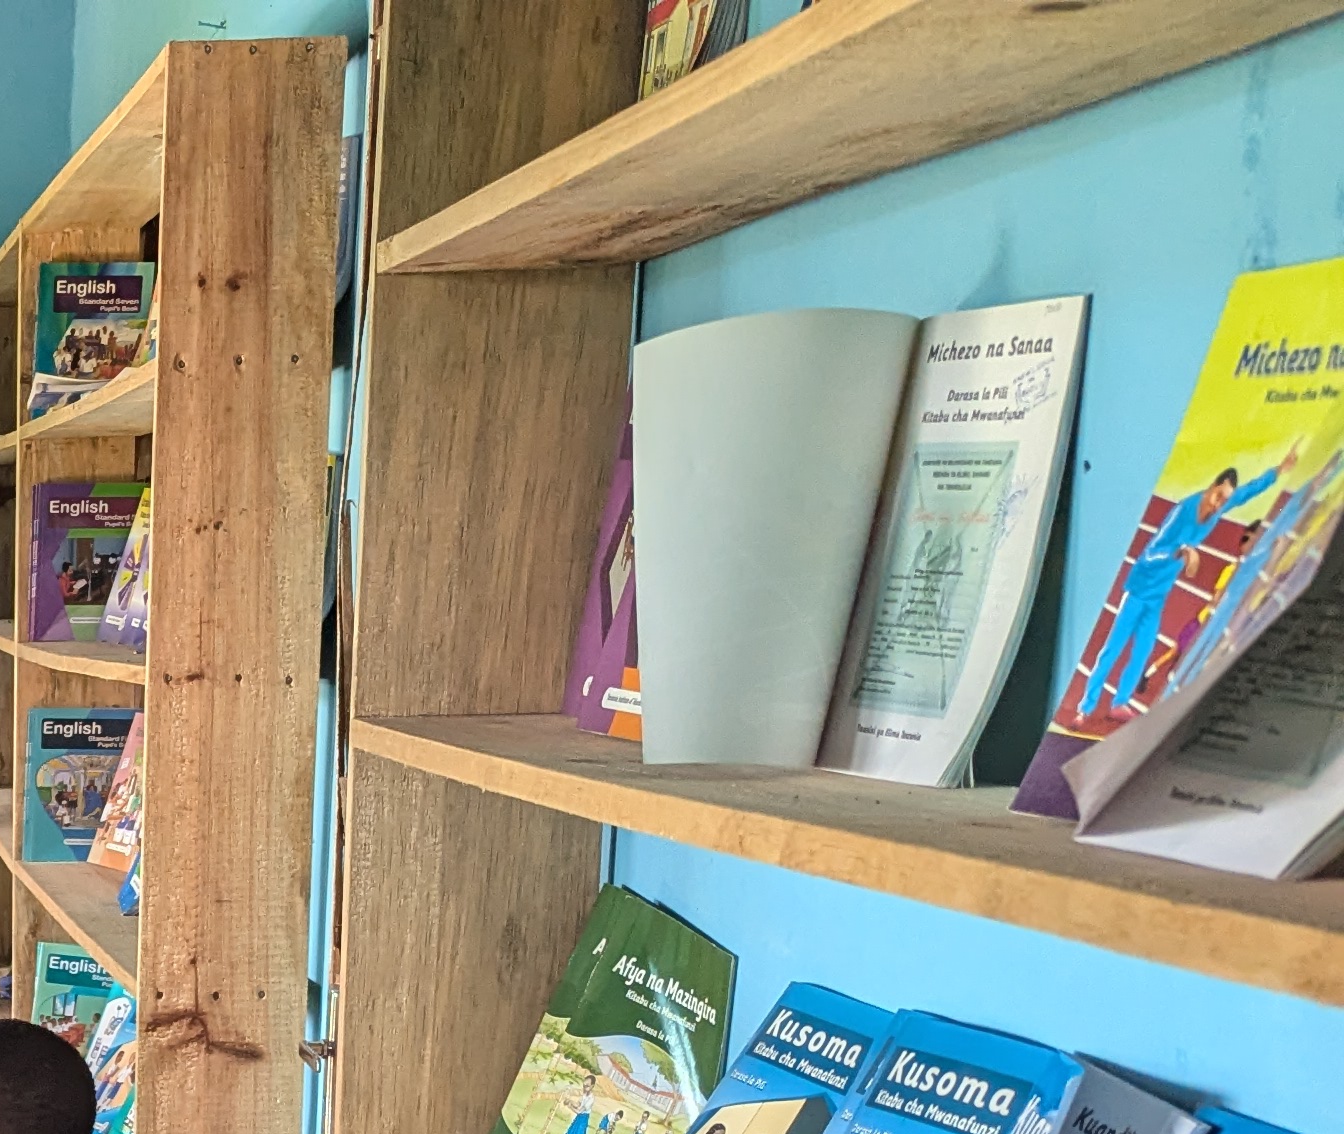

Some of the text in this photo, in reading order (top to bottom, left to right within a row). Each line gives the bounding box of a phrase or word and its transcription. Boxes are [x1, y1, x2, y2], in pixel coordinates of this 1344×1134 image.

[56, 280, 116, 297] English
[927, 336, 1053, 363] Michezo na Sanaa
[1234, 337, 1322, 379] Michezo
[947, 386, 1008, 402] Darasa la Pili
[922, 410, 949, 423] Kitabu
[952, 409, 968, 422] cha
[49, 500, 109, 517] English
[43, 721, 102, 738] English
[592, 938, 606, 954] A
[612, 955, 716, 1024] Afya na Mazingira
[626, 989, 696, 1032] Kitabu cha Mwanafunzi
[636, 1020, 664, 1040] Darasa la
[766, 1009, 862, 1068] Kusoma
[753, 1041, 848, 1090] Kitabu cha Mwanafunzi
[887, 1050, 1015, 1116] Kusoma
[875, 1089, 904, 1109] Kitabu
[904, 1098, 924, 1116] cha
